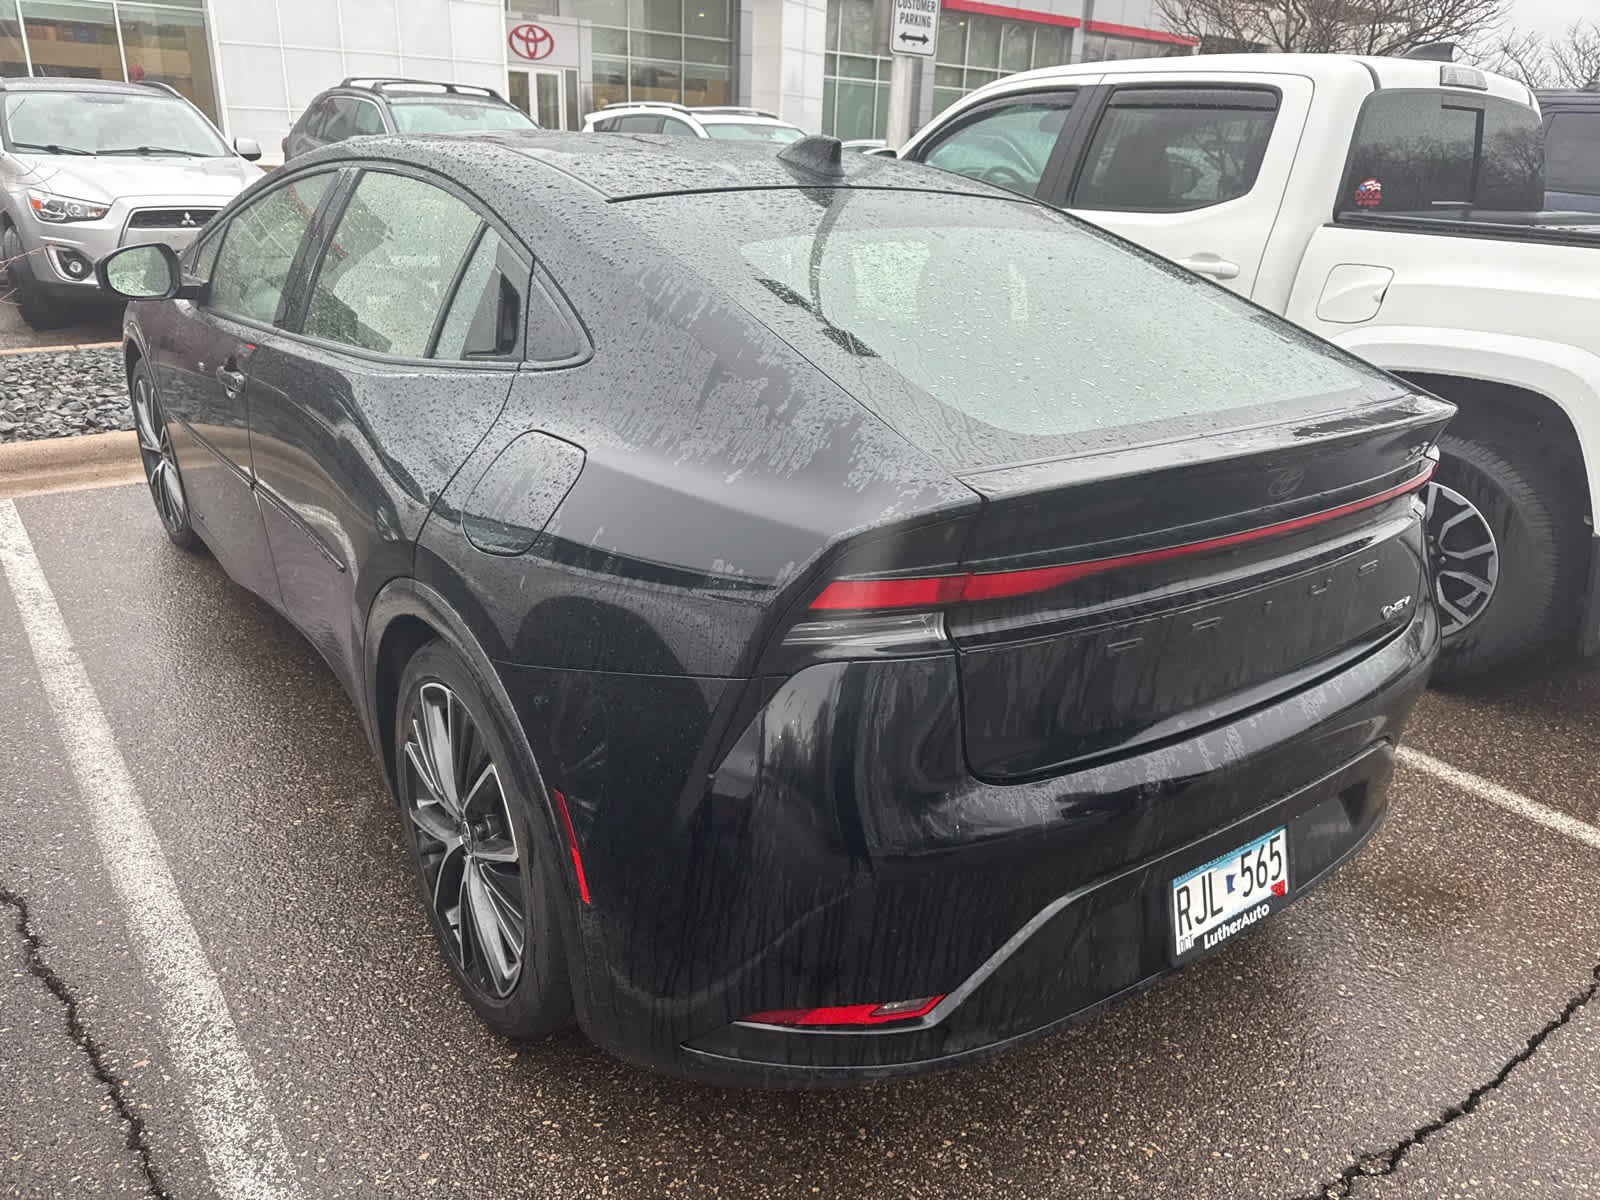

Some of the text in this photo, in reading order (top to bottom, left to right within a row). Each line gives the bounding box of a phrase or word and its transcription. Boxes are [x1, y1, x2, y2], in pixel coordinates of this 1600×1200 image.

[897, 0, 936, 12] CUSTOMER
[899, 12, 931, 28] PARKING
[1176, 871, 1224, 937] RJL
[1240, 835, 1282, 898] 565
